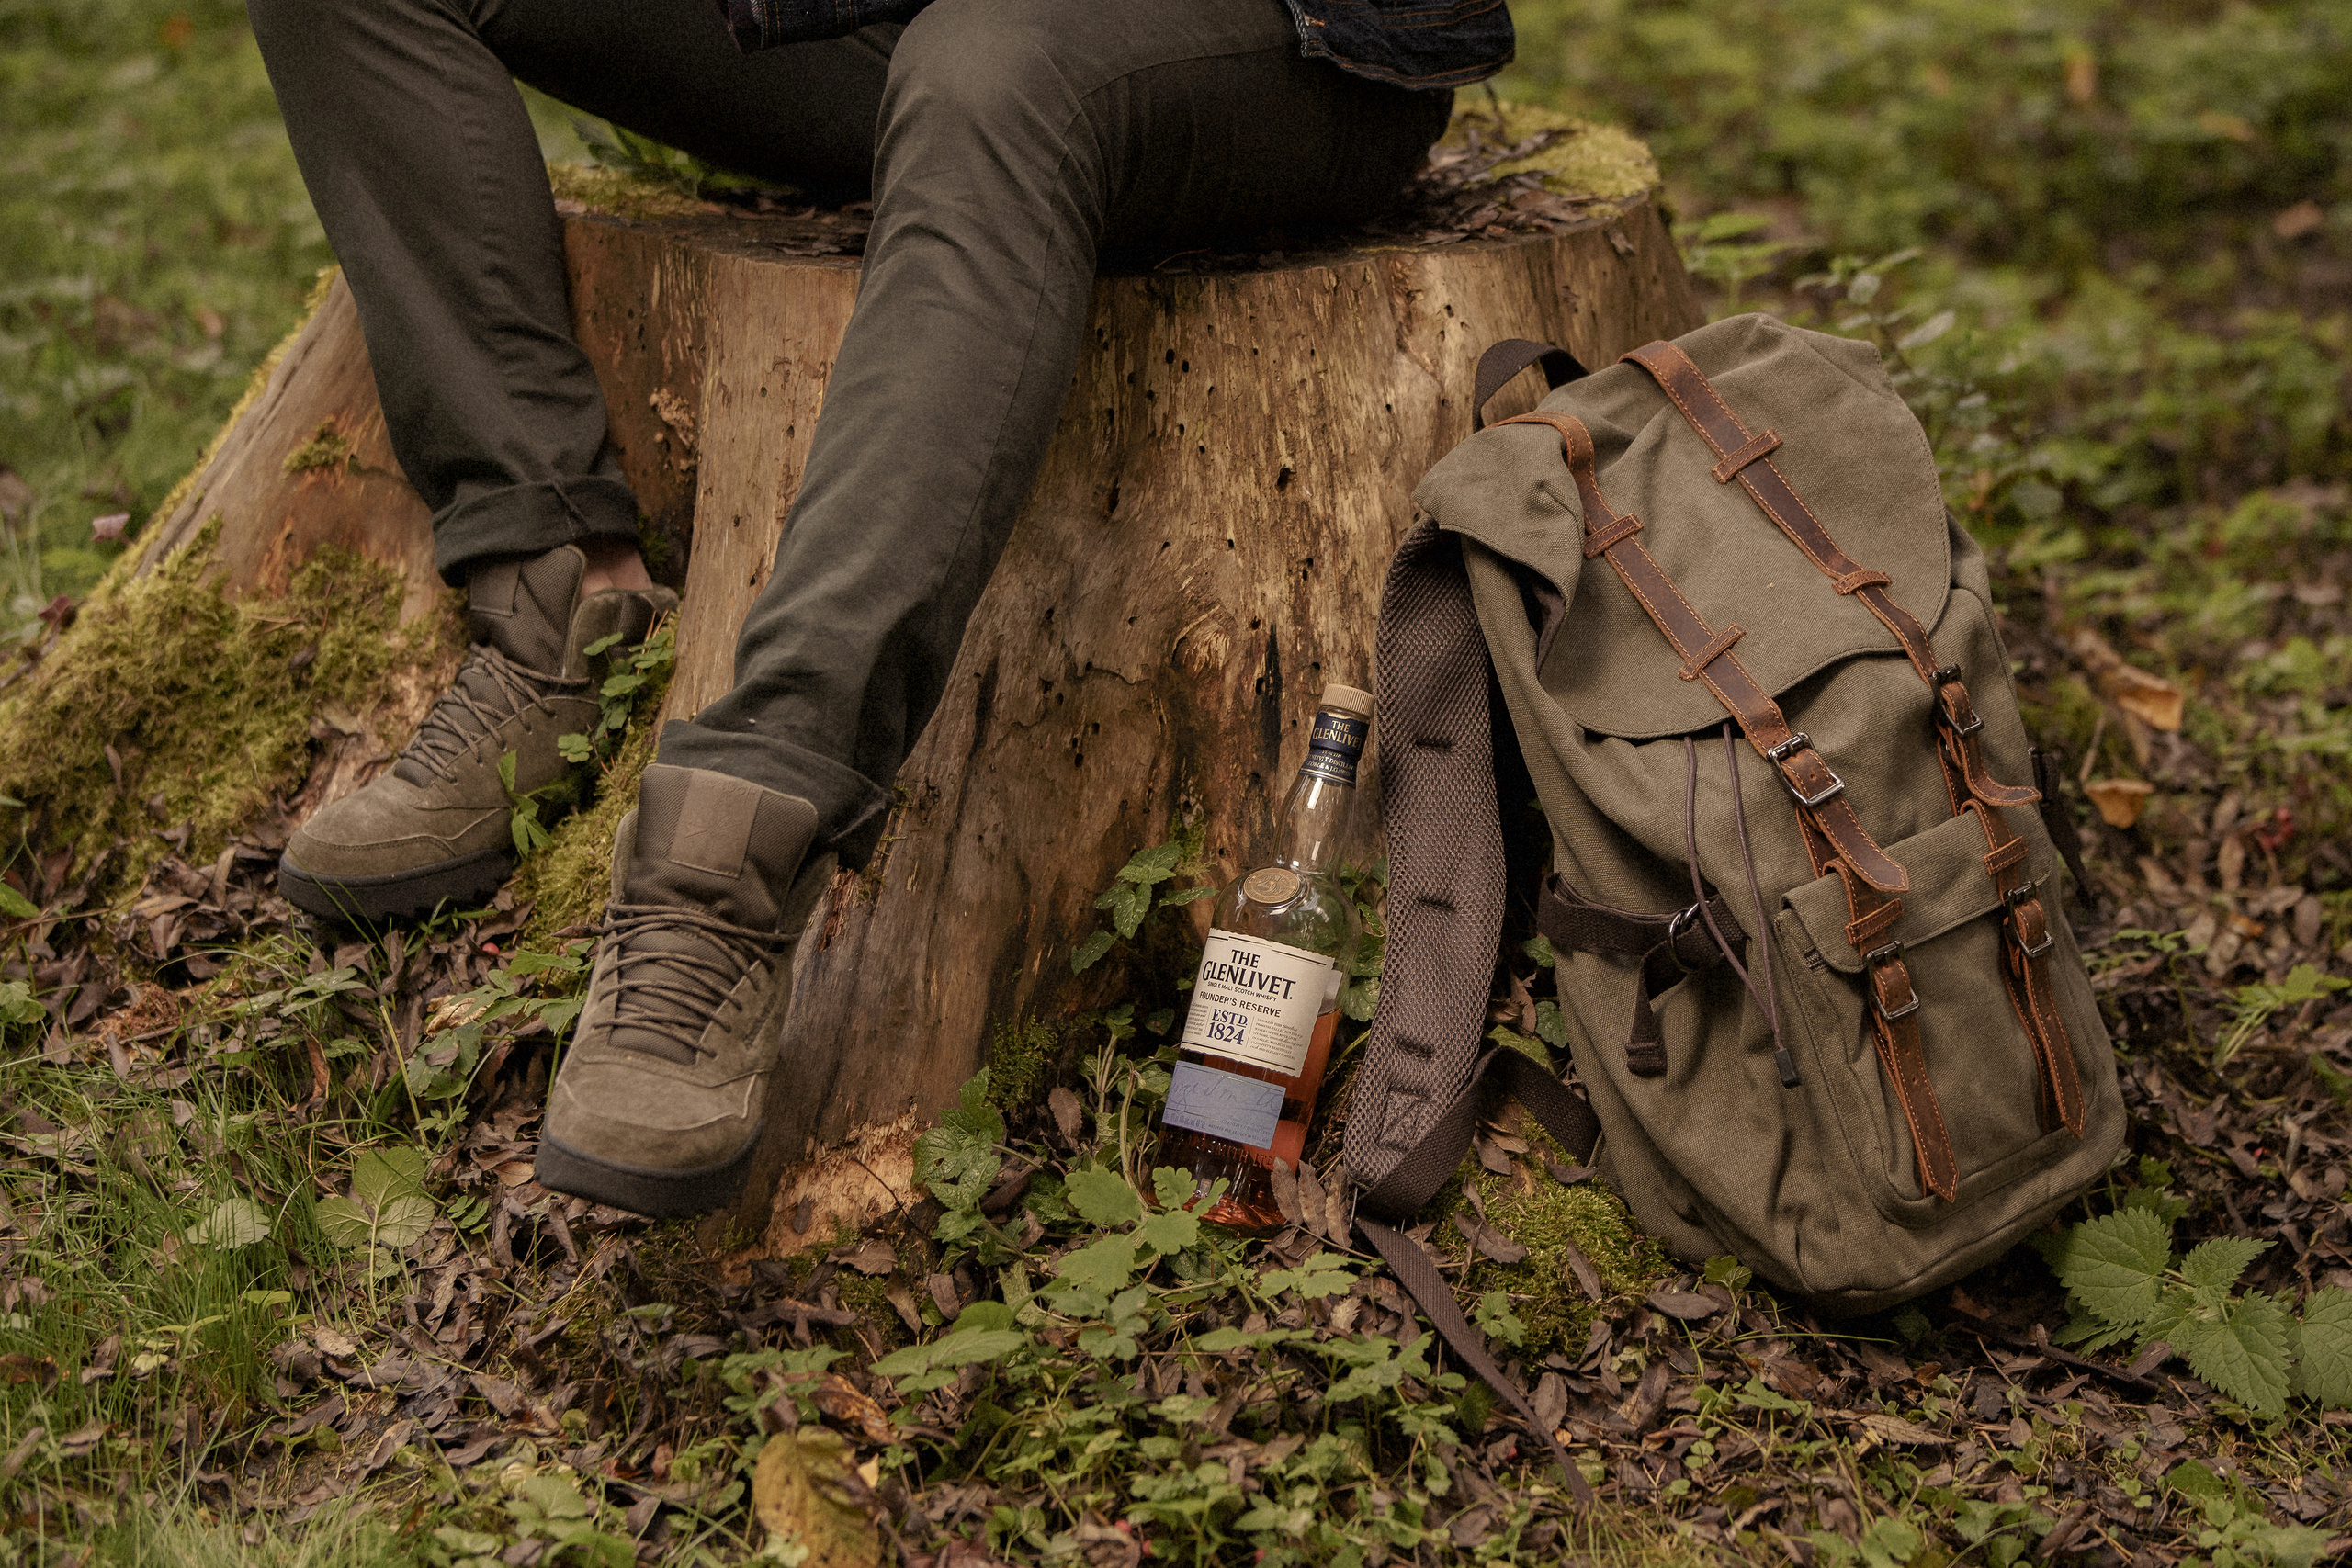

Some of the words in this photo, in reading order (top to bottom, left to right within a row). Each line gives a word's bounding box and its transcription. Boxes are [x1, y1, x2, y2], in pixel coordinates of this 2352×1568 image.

[1332, 720, 1351, 733] THE
[1231, 949, 1261, 968] THE
[1207, 980, 1221, 988] SINGLE
[1234, 987, 1255, 997] SCOTCH
[1255, 991, 1278, 1002] WHISKY
[1199, 991, 1238, 1007] FOUNDER'S
[1238, 999, 1282, 1018] RESERVE
[1206, 1021, 1244, 1046] 1824
